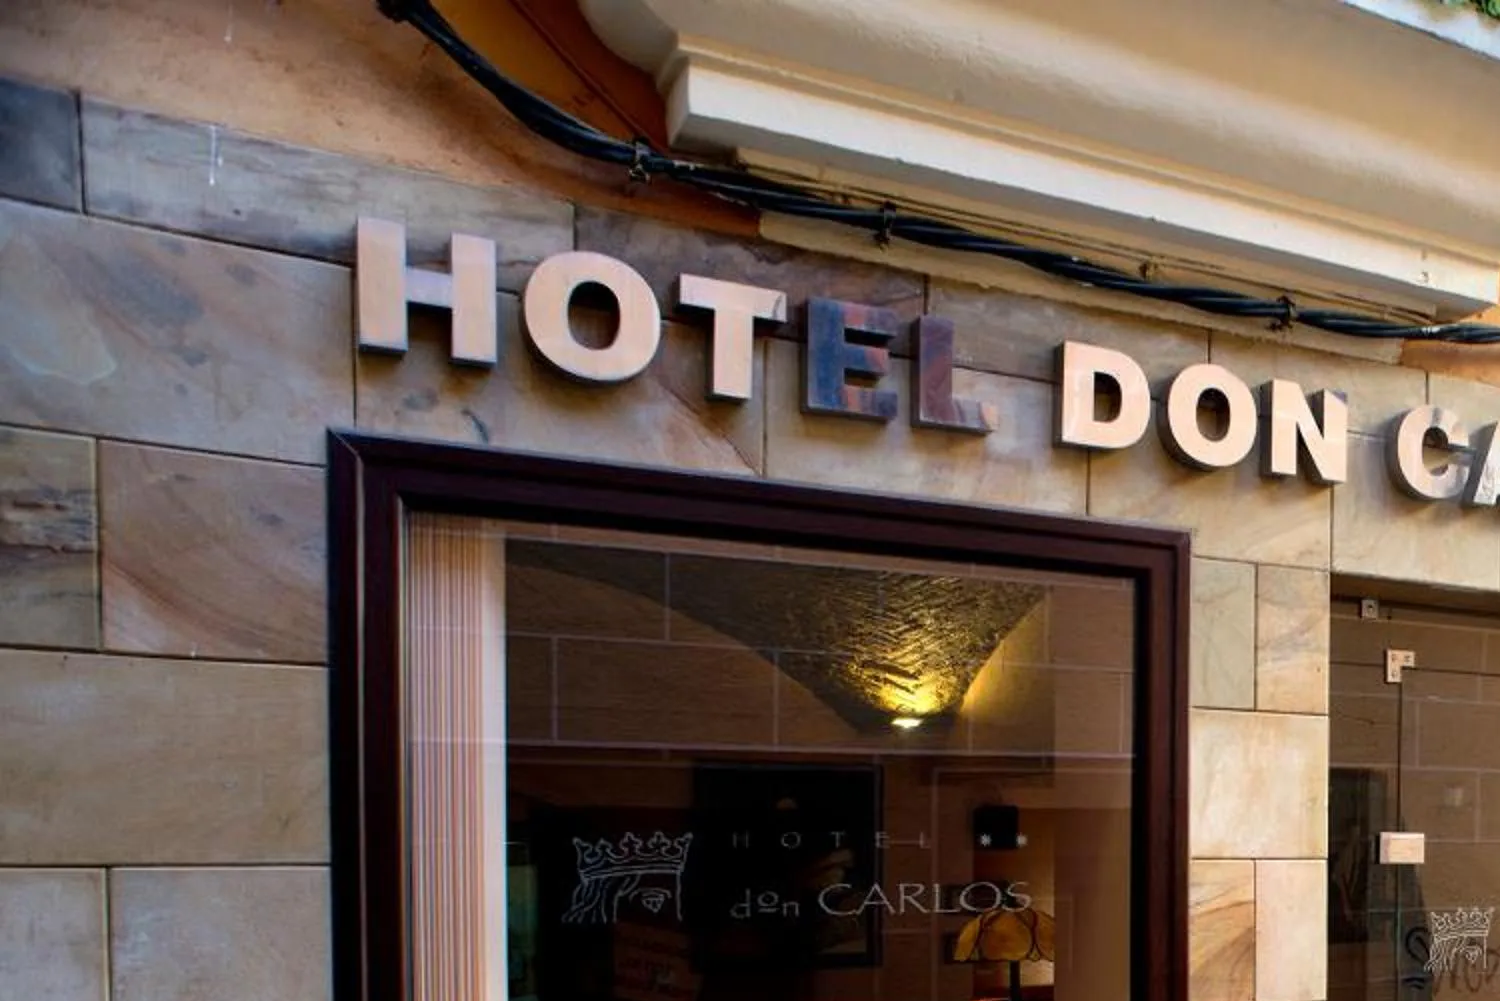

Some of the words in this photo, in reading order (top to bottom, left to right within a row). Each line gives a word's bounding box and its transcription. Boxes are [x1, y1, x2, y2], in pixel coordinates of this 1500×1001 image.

[356, 217, 995, 435] HOTEL
[1056, 340, 1349, 486] DON
[733, 830, 931, 848] HOTEL
[730, 888, 799, 919] don
[818, 881, 1033, 916] CARLOS
